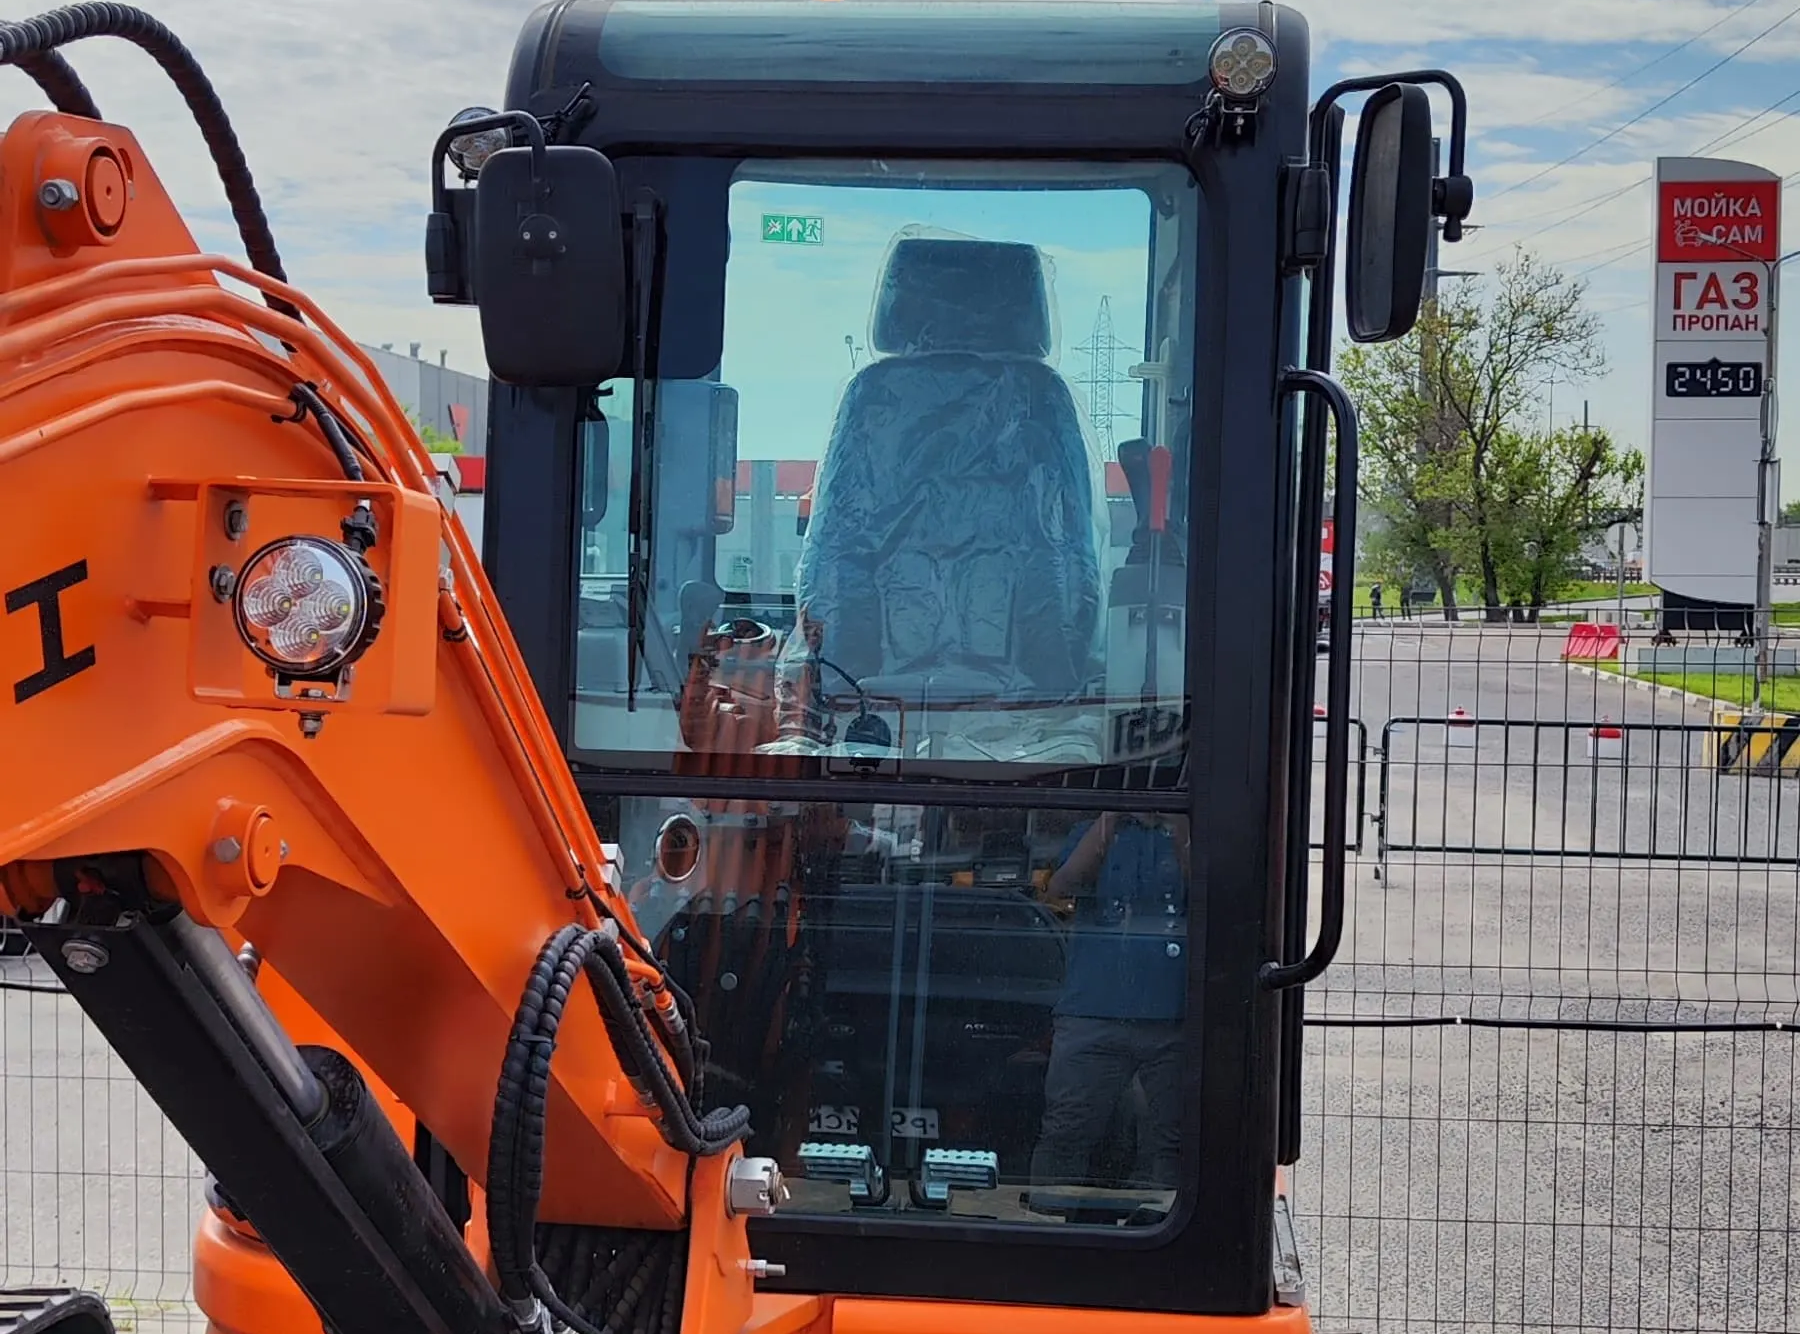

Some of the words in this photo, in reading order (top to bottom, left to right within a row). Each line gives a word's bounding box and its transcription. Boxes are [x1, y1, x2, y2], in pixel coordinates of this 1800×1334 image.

[1673, 192, 1762, 218] МОЙКА
[1711, 224, 1763, 245] САМ
[1672, 271, 1760, 311] ГАЗ
[1672, 314, 1759, 332] ПРОПАН
[1674, 367, 1755, 395] 24.50
